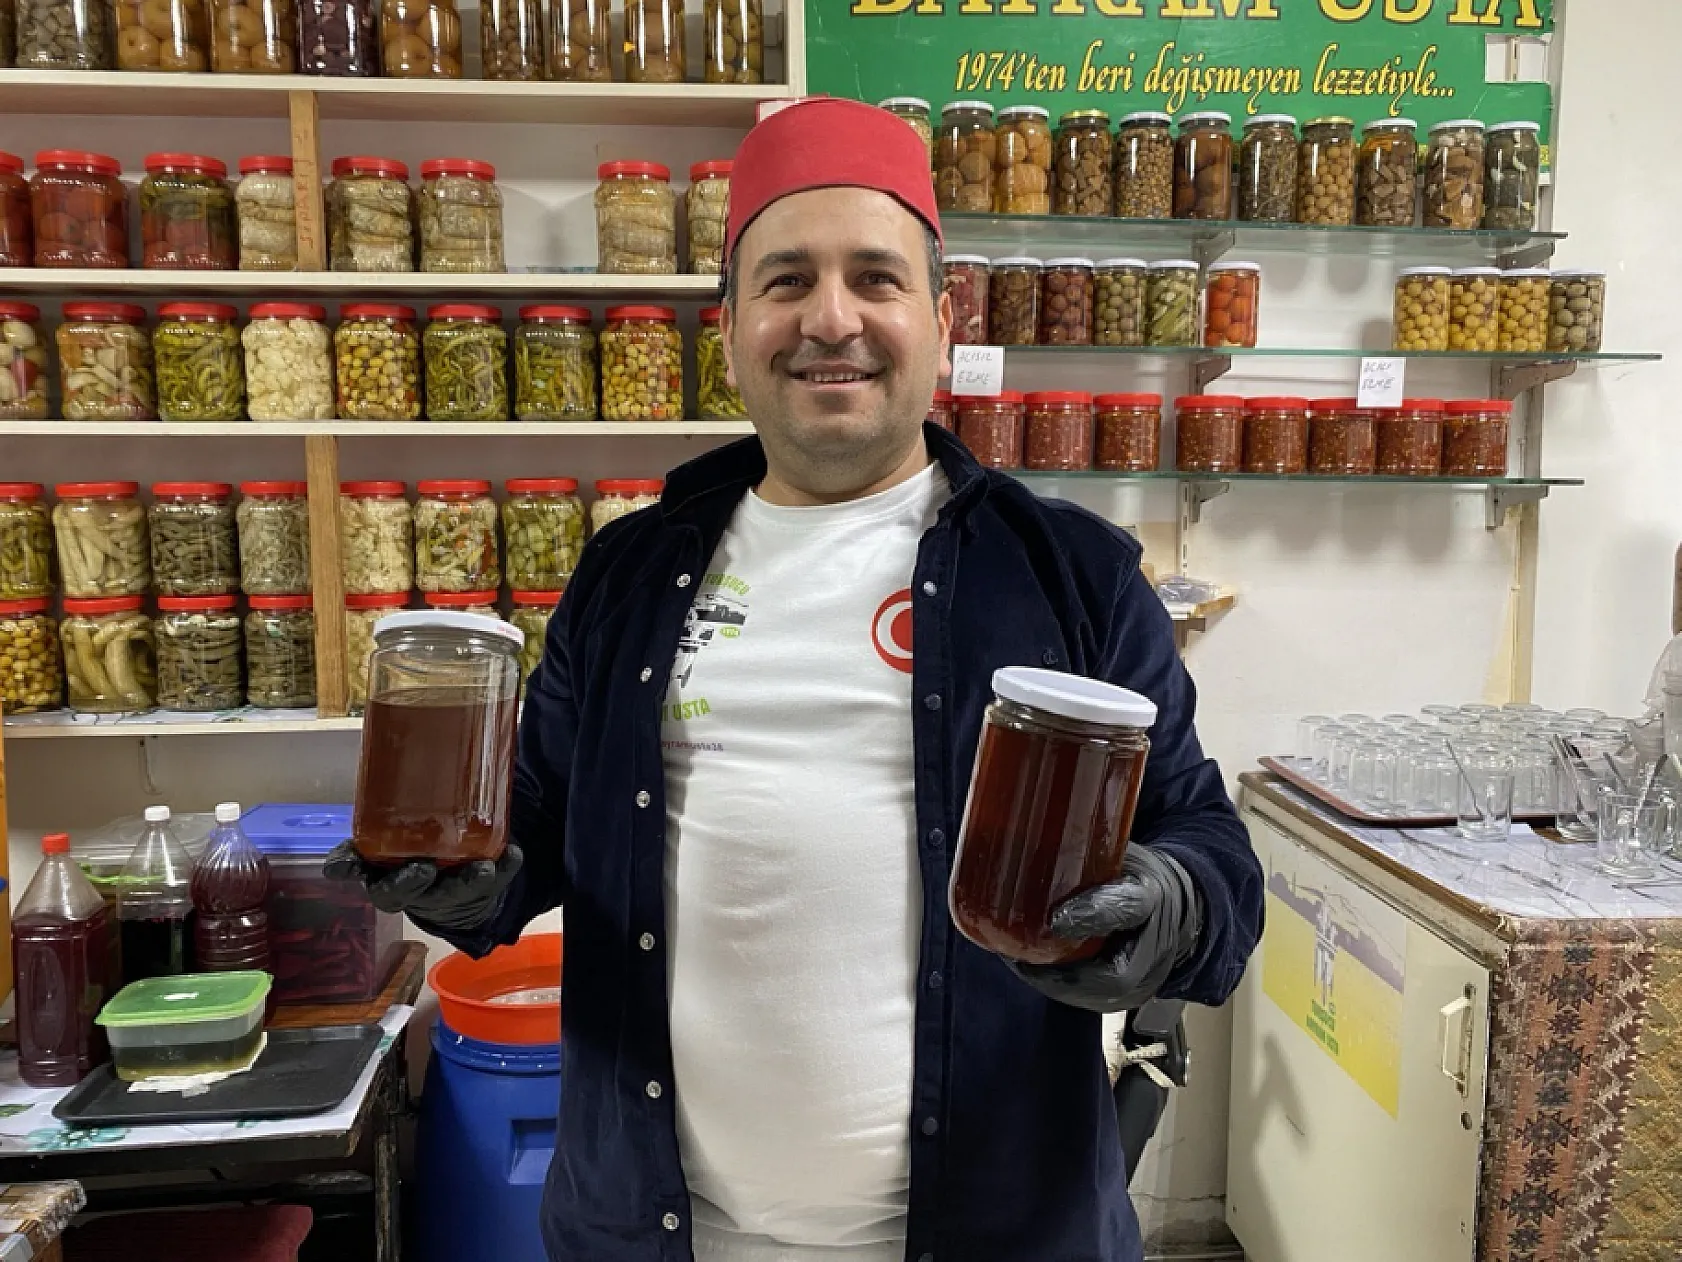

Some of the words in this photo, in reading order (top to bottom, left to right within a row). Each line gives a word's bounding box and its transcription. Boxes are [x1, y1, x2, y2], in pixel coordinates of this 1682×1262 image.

[955, 51, 1067, 92] 1974'ten
[1077, 40, 1137, 93] beri
[1143, 41, 1303, 115] değişmeyen
[1313, 43, 1456, 117] lezzetiyle...
[673, 697, 711, 720] USTA
